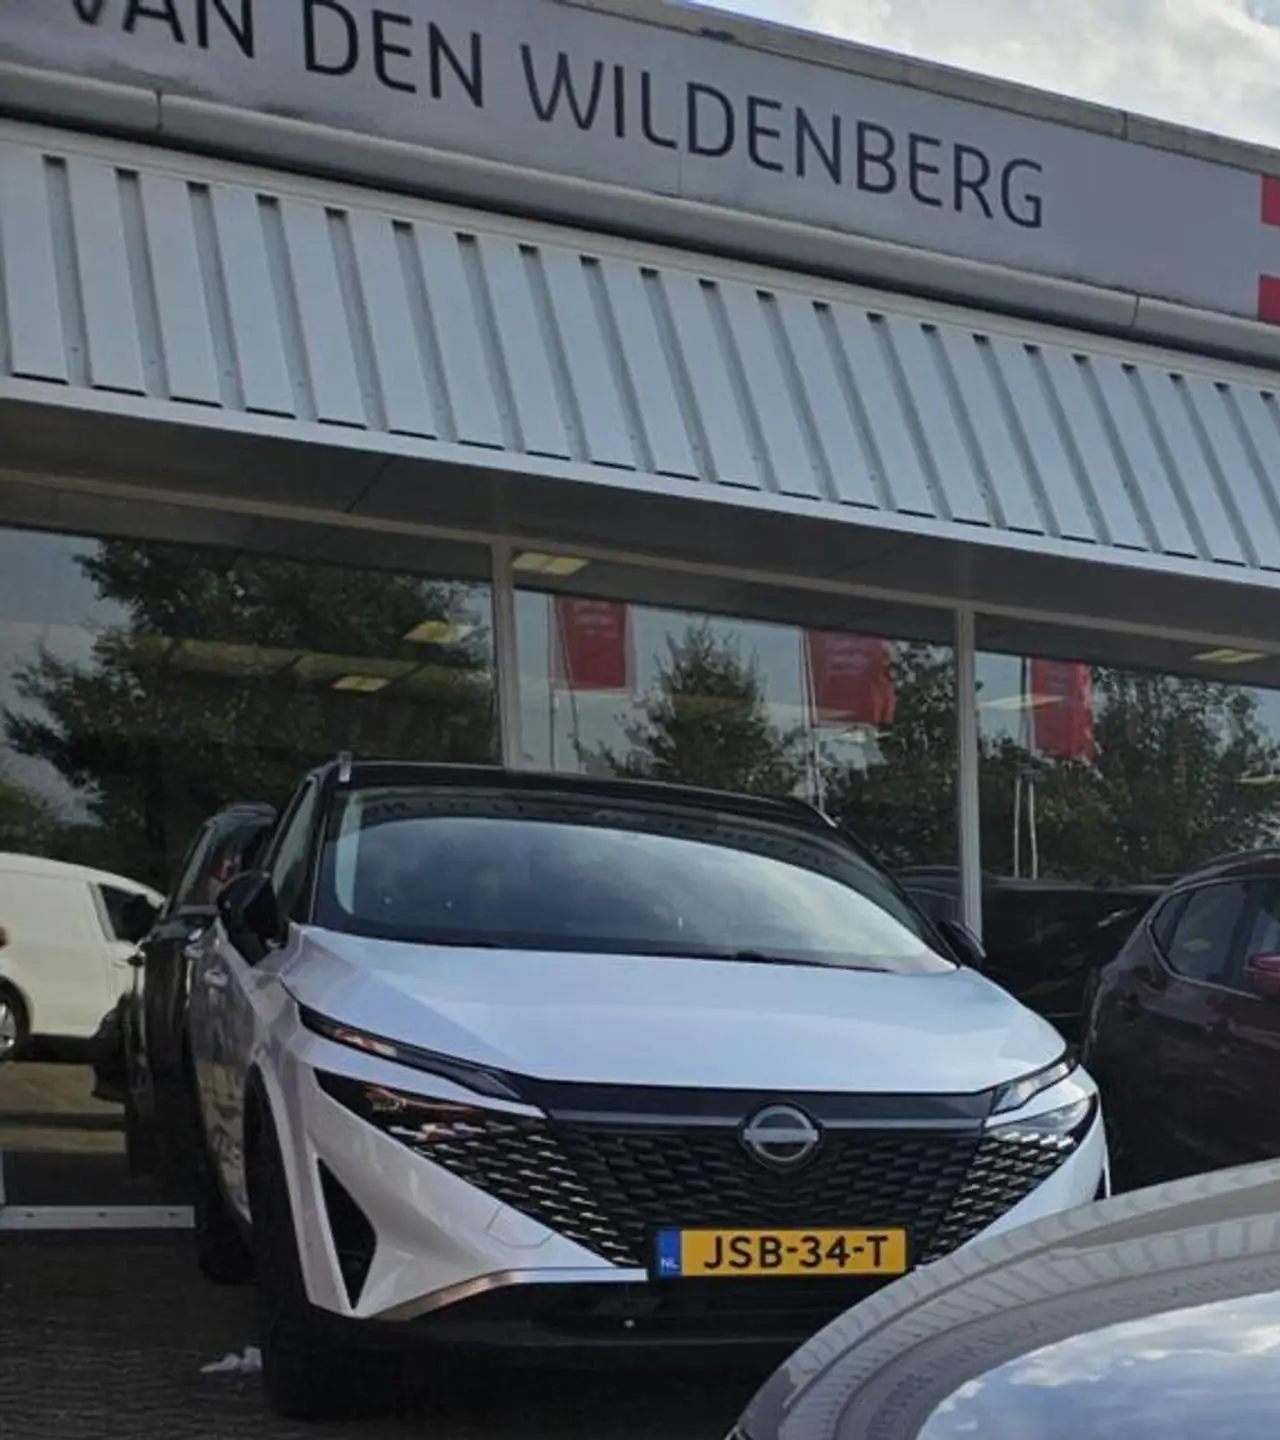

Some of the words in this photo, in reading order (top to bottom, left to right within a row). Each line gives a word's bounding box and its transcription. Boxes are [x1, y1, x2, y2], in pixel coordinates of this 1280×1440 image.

[304, 0, 483, 107] DEN
[520, 44, 1043, 228] WILDENBERG
[703, 1235, 889, 1269] JSB-34-T
